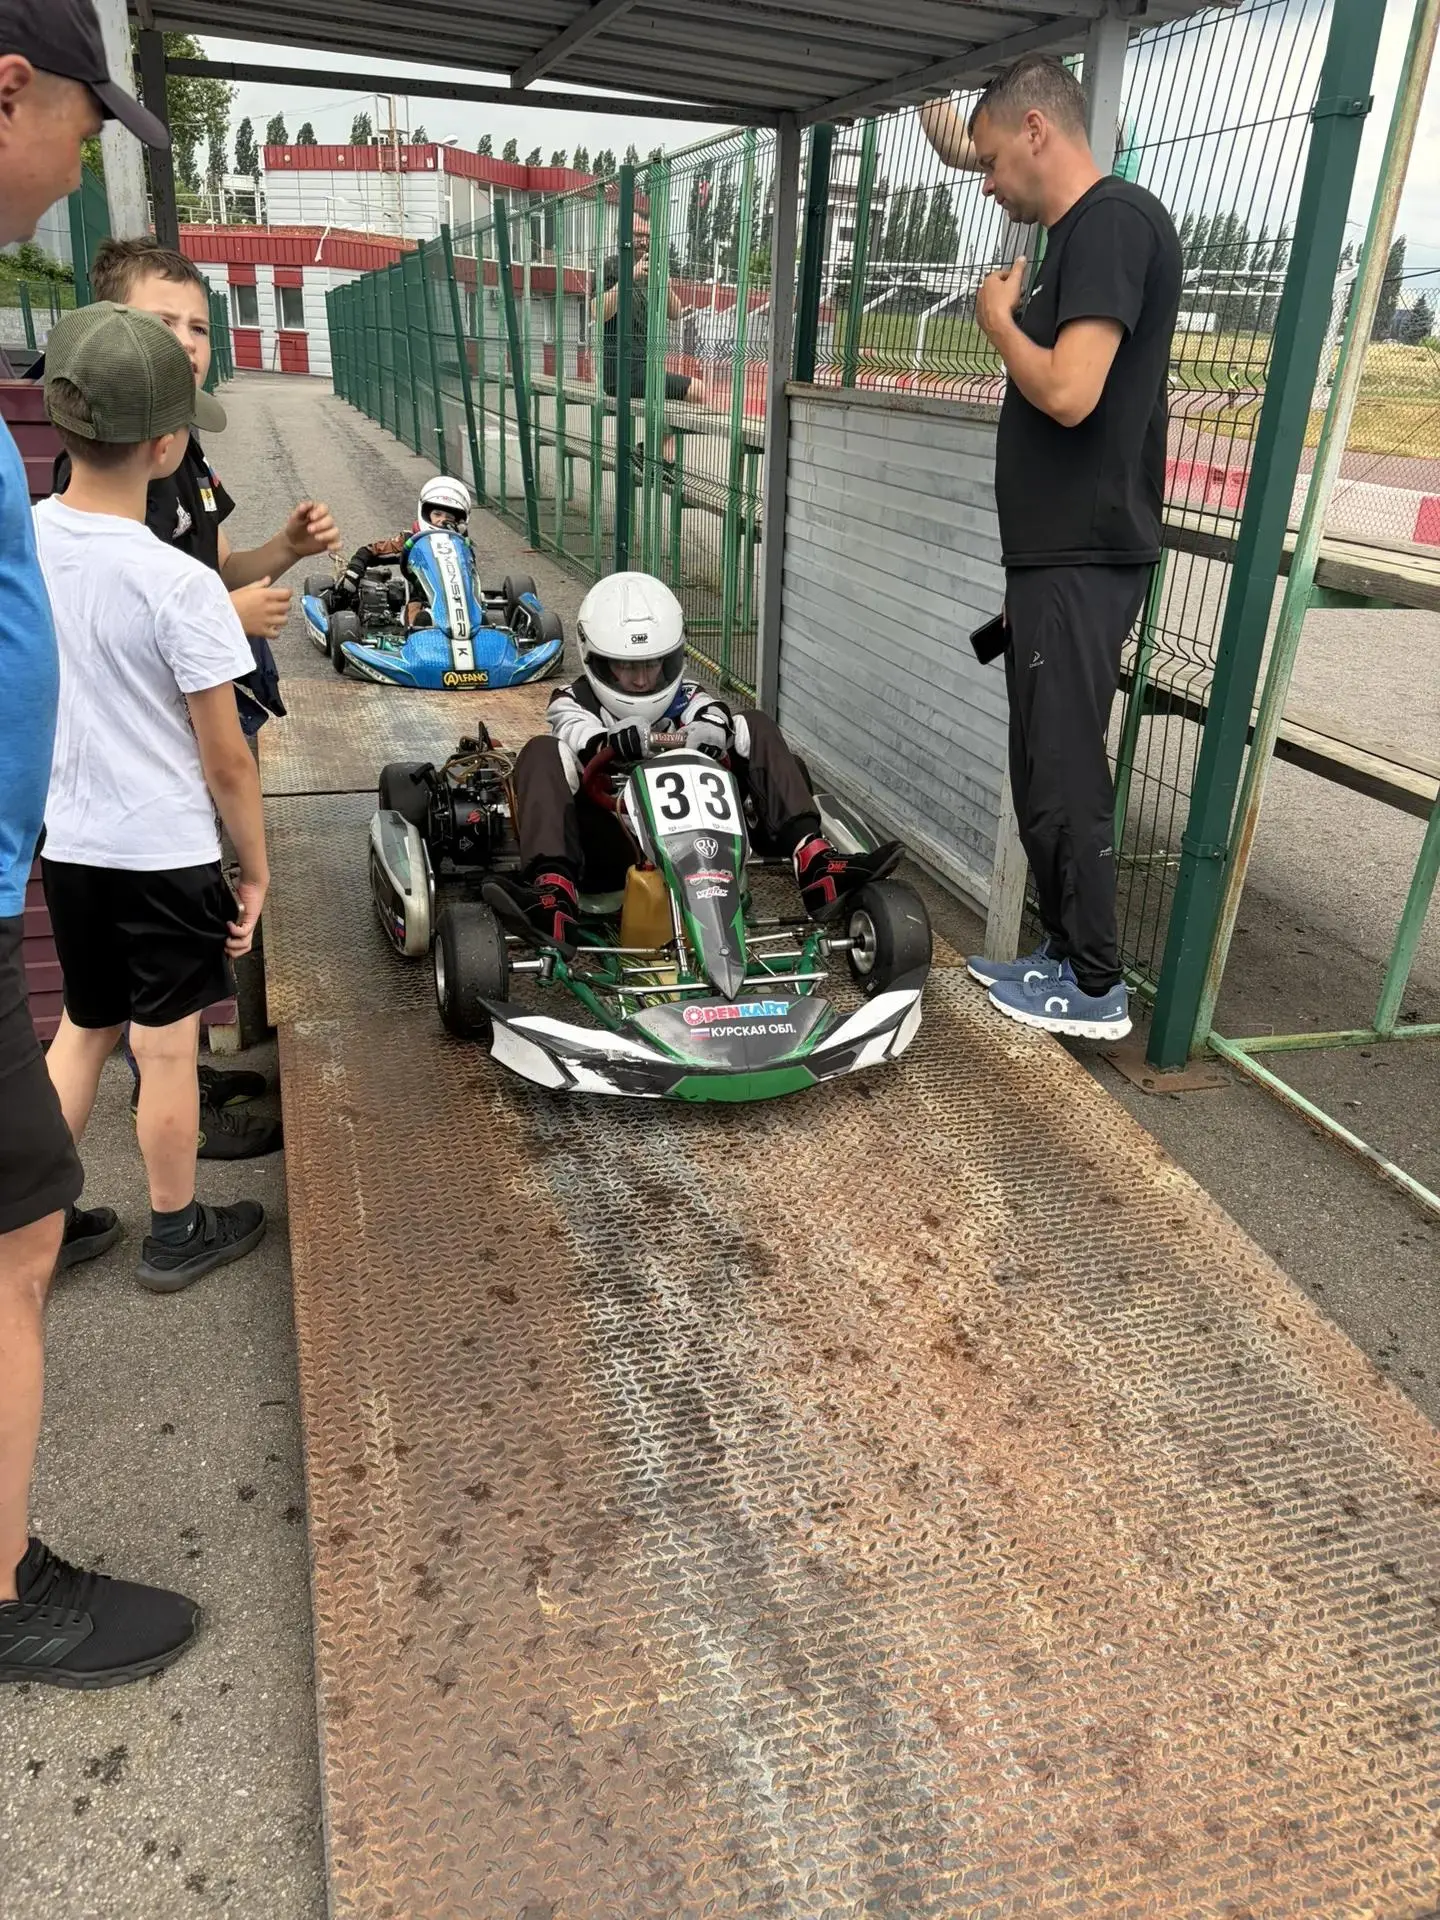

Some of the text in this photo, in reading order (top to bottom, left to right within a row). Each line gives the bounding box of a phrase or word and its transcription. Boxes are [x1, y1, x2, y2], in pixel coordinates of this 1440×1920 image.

[631, 633, 648, 644] OMP
[457, 647, 469, 657] K
[443, 671, 489, 686] ALFANO
[655, 772, 732, 821] 33
[711, 1023, 797, 1038] КУРСКАЯ ОБЛ.
